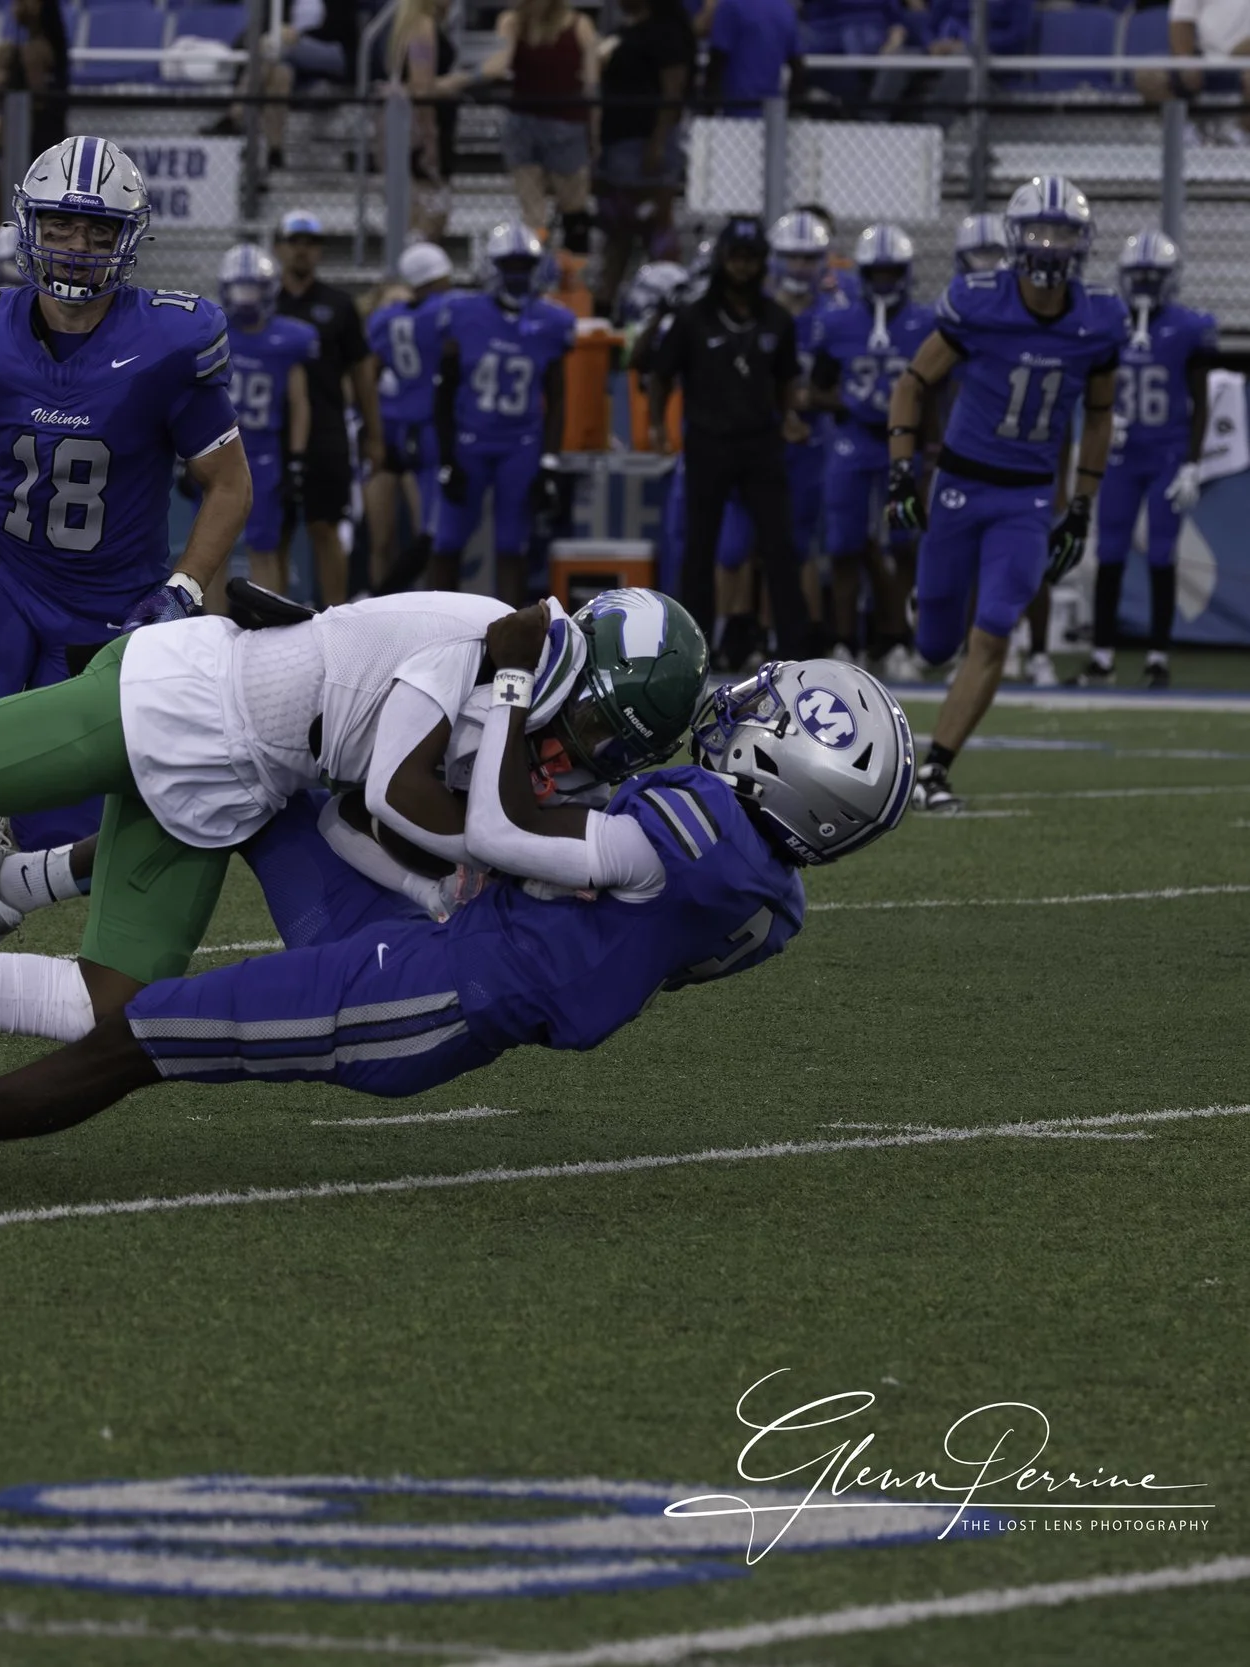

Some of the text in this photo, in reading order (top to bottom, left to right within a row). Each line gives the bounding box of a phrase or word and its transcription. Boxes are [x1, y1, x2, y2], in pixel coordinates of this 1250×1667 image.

[66, 194, 100, 205] Vikings
[472, 352, 534, 415] 43
[995, 366, 1063, 441] 11
[30, 408, 92, 430] Vikings
[4, 434, 111, 552] 18
[623, 706, 654, 739] Riddell
[798, 690, 854, 745] M
